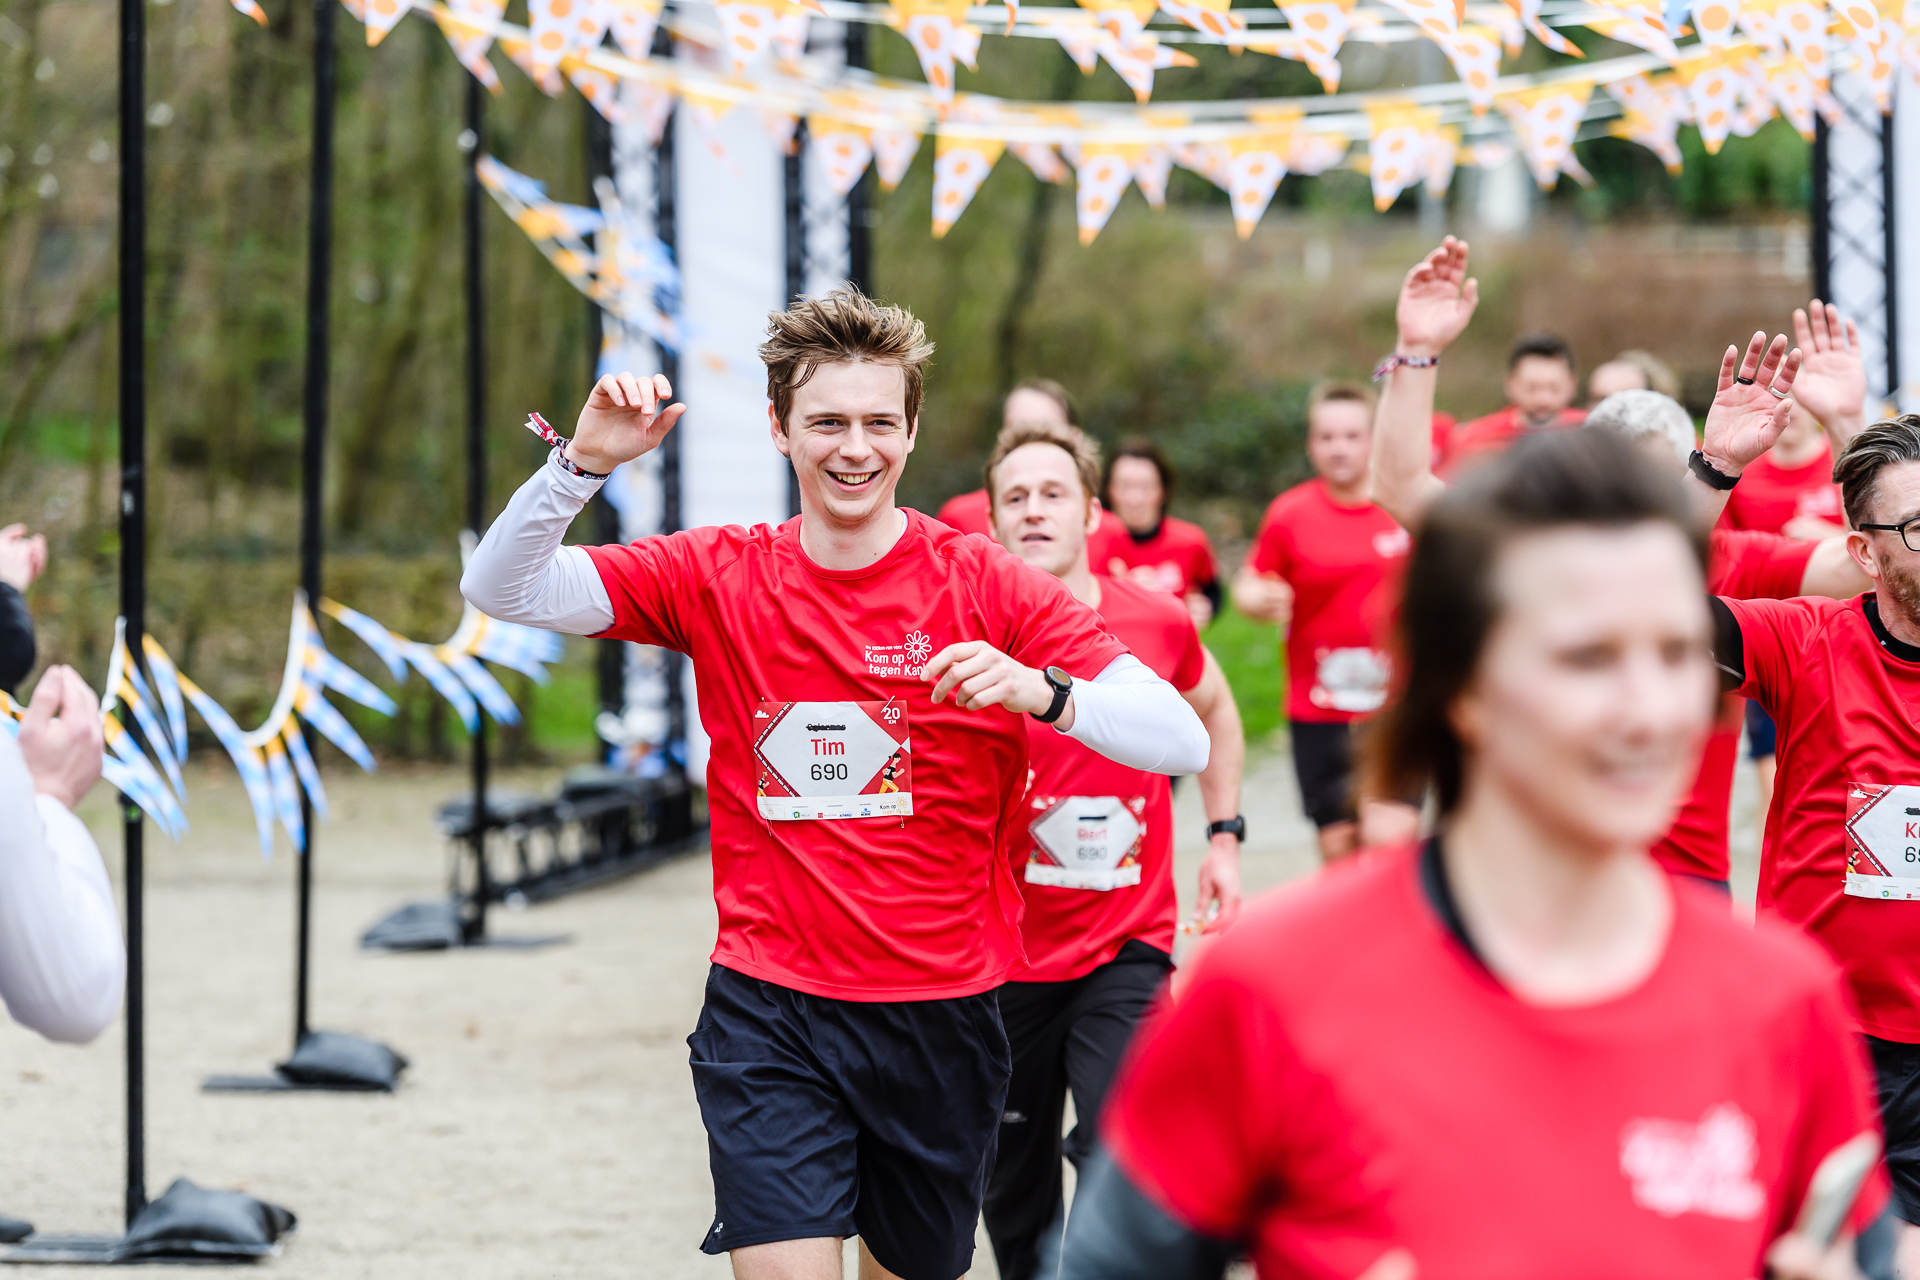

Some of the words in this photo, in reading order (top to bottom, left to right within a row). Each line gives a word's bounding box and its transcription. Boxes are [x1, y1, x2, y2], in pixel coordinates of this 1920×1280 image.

[864, 649, 889, 664] Kom
[891, 653, 905, 667] op
[868, 663, 901, 678] tegen
[883, 707, 901, 720] 20
[810, 738, 845, 756] Tim
[810, 763, 848, 781] 690
[1076, 827, 1108, 841] Bert
[1905, 821, 1920, 839] K
[1076, 845, 1108, 861] 690
[1904, 846, 1920, 863] 6
